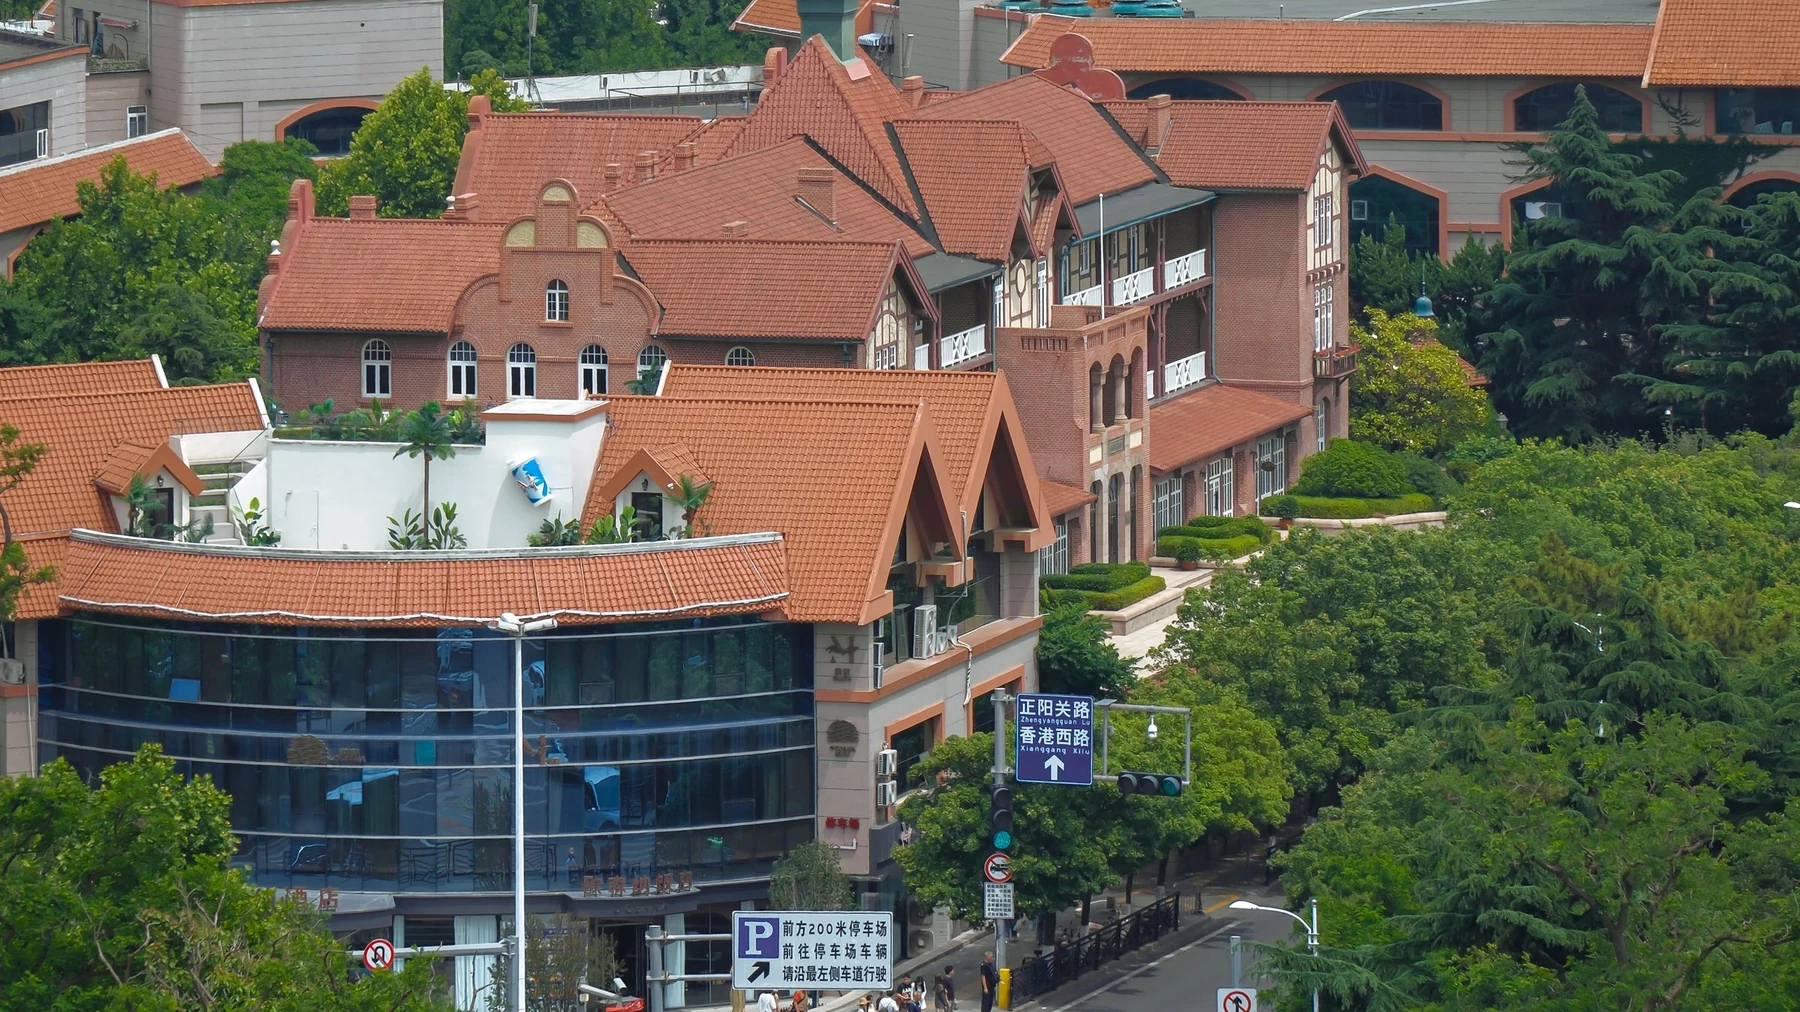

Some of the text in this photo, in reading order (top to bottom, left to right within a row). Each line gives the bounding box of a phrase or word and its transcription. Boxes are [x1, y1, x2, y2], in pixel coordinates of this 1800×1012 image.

[1020, 699, 1090, 719] 正阳关路
[1020, 716, 1078, 726] Zhengyangguan
[1020, 726, 1090, 747] 香港西路
[1020, 745, 1067, 755] Xianggang
[782, 920, 887, 937] 前方200米停车场
[744, 921, 774, 955] P
[782, 943, 888, 960] 前往停车场车辆
[782, 965, 887, 982] 请沿最左侧车道行驶
